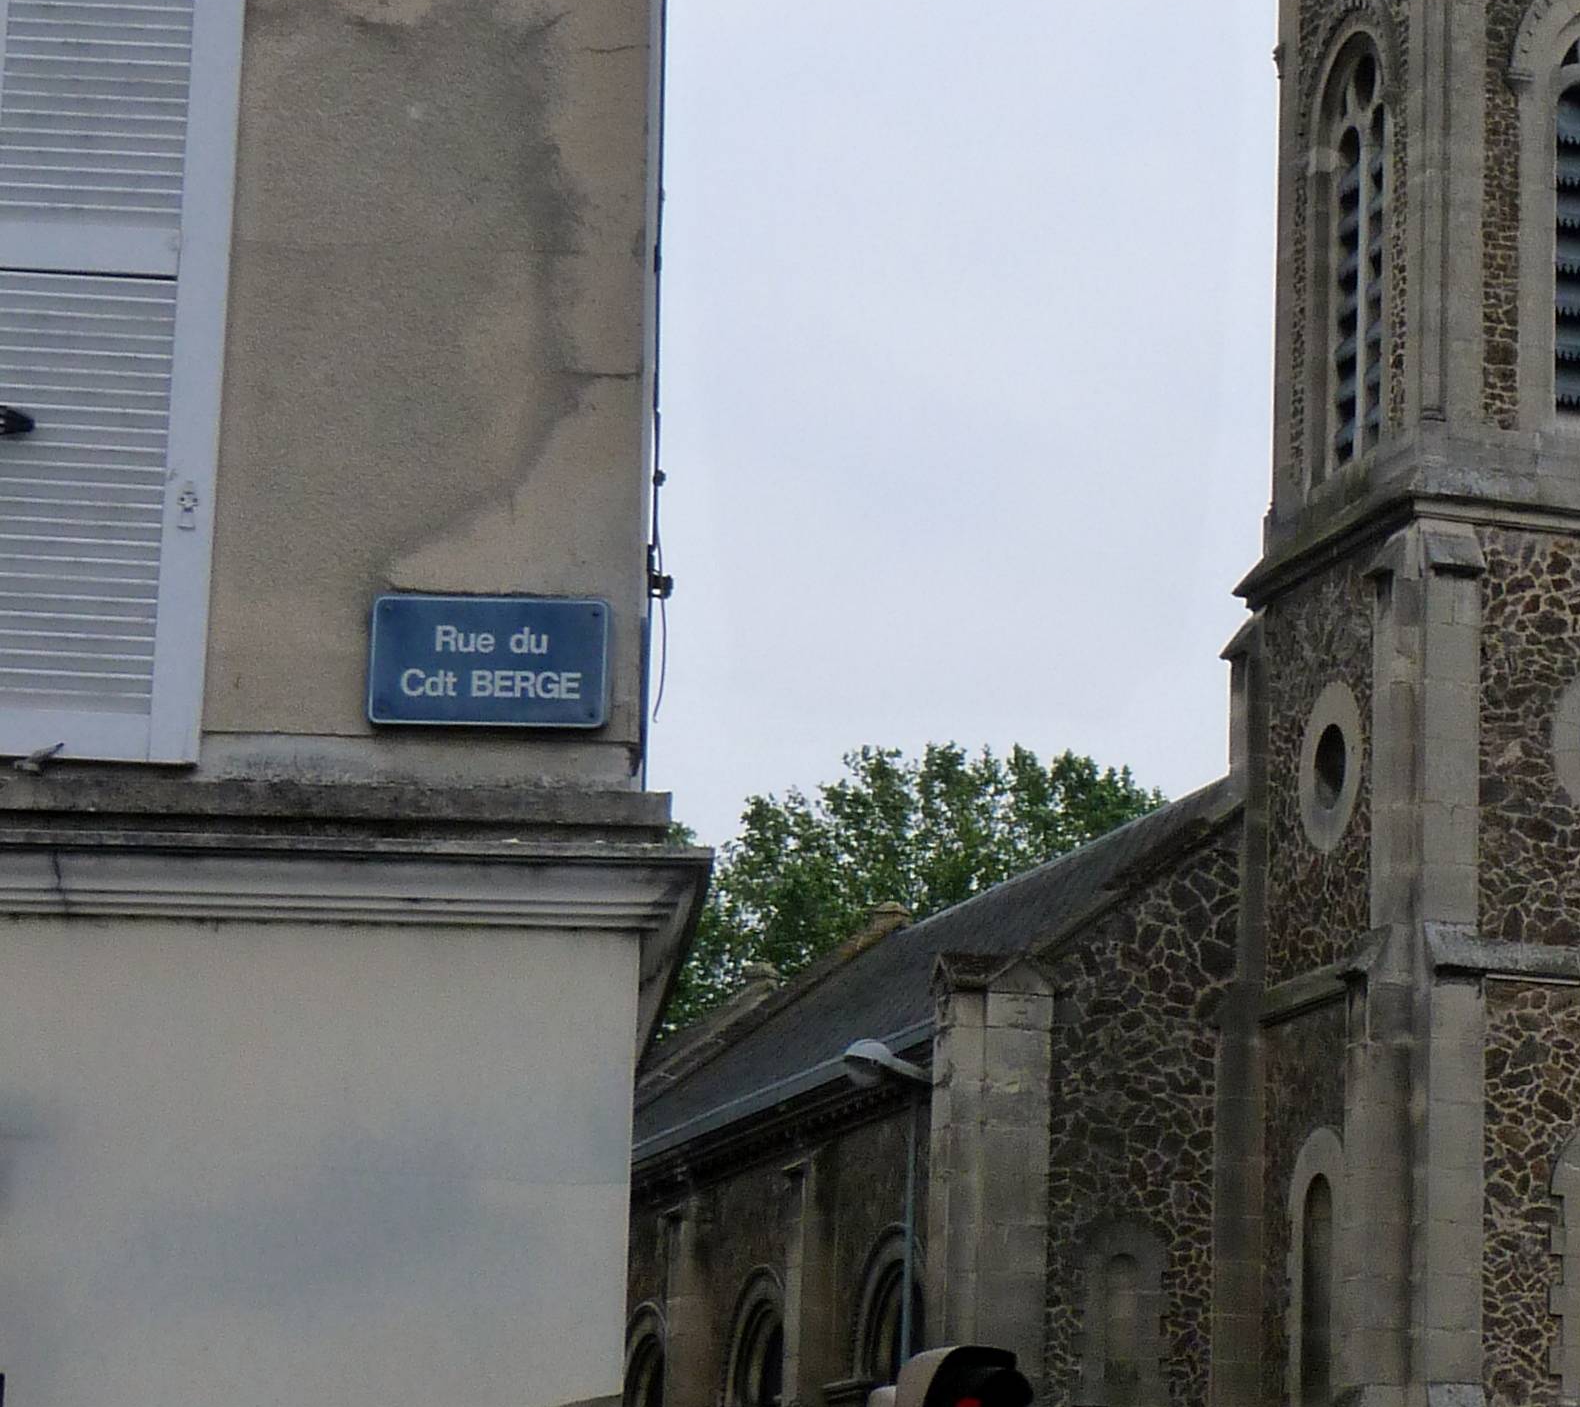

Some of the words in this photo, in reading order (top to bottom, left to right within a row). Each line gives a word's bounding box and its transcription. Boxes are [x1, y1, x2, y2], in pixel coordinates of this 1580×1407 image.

[434, 625, 495, 653] Rue
[509, 626, 549, 654] du
[401, 668, 458, 697] Cdt
[471, 670, 582, 700] BERGE
